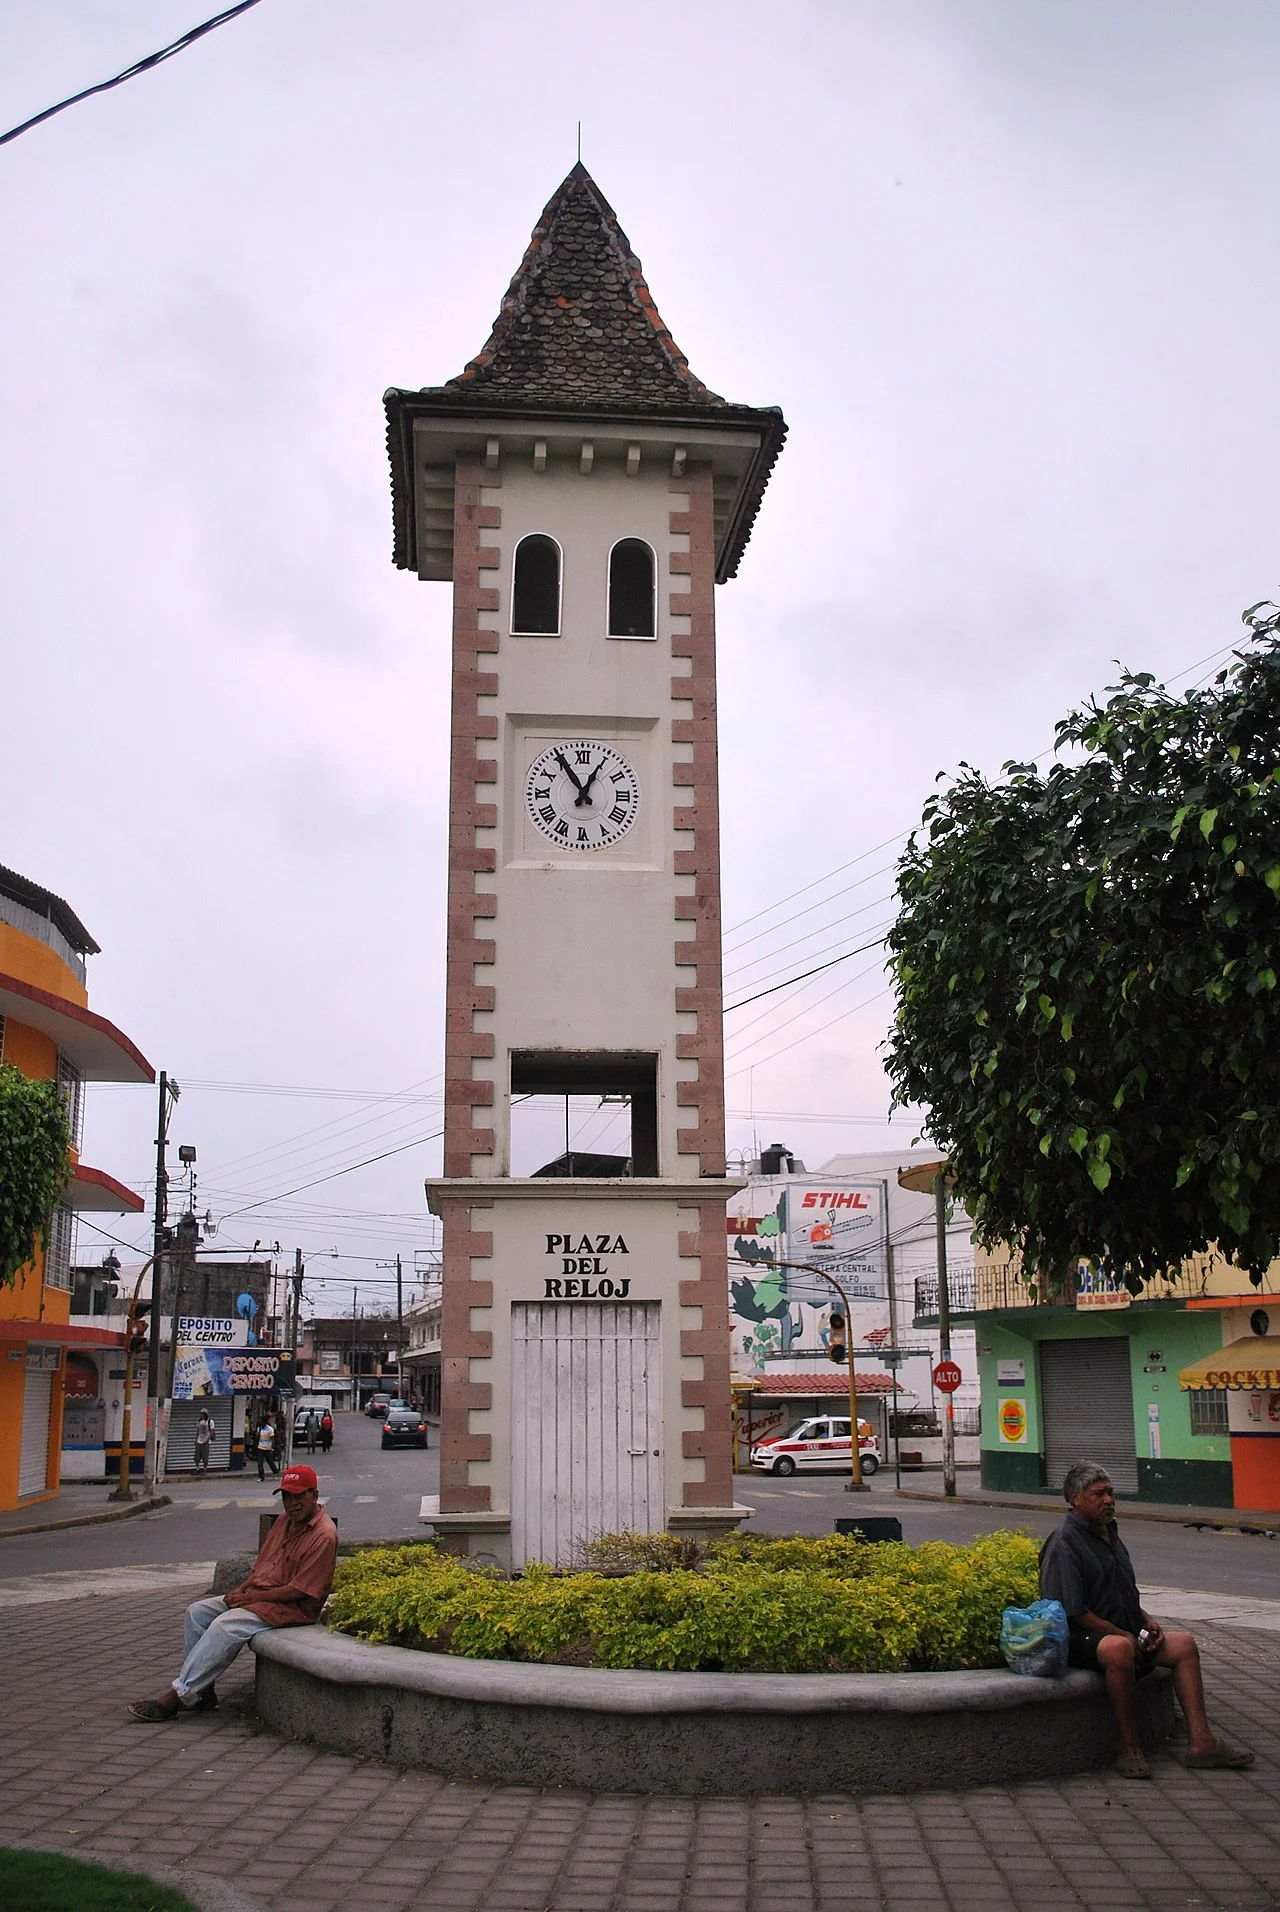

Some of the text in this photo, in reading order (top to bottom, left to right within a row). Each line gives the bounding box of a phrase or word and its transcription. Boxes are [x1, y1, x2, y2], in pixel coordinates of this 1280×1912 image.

[574, 750, 591, 765] XII
[541, 769, 557, 783] X
[609, 771, 625, 784] II
[535, 787, 550, 800] IX
[615, 790, 630, 803] III
[538, 805, 557, 825] VIII
[553, 818, 568, 837] VII
[576, 827, 590, 841] VI
[599, 823, 610, 837] V
[801, 1192, 868, 1209] STIHL
[545, 1234, 630, 1254] PLAZA
[562, 1257, 608, 1275] DEL
[842, 1264, 877, 1273] CENTRAL
[835, 1275, 860, 1283] GOLFO
[544, 1278, 631, 1298] RELOJ
[171, 1318, 232, 1331] EPOSITO
[222, 1356, 280, 1372] DEPOSITO
[228, 1374, 274, 1389] CENTRO
[936, 1371, 959, 1383] ALTO
